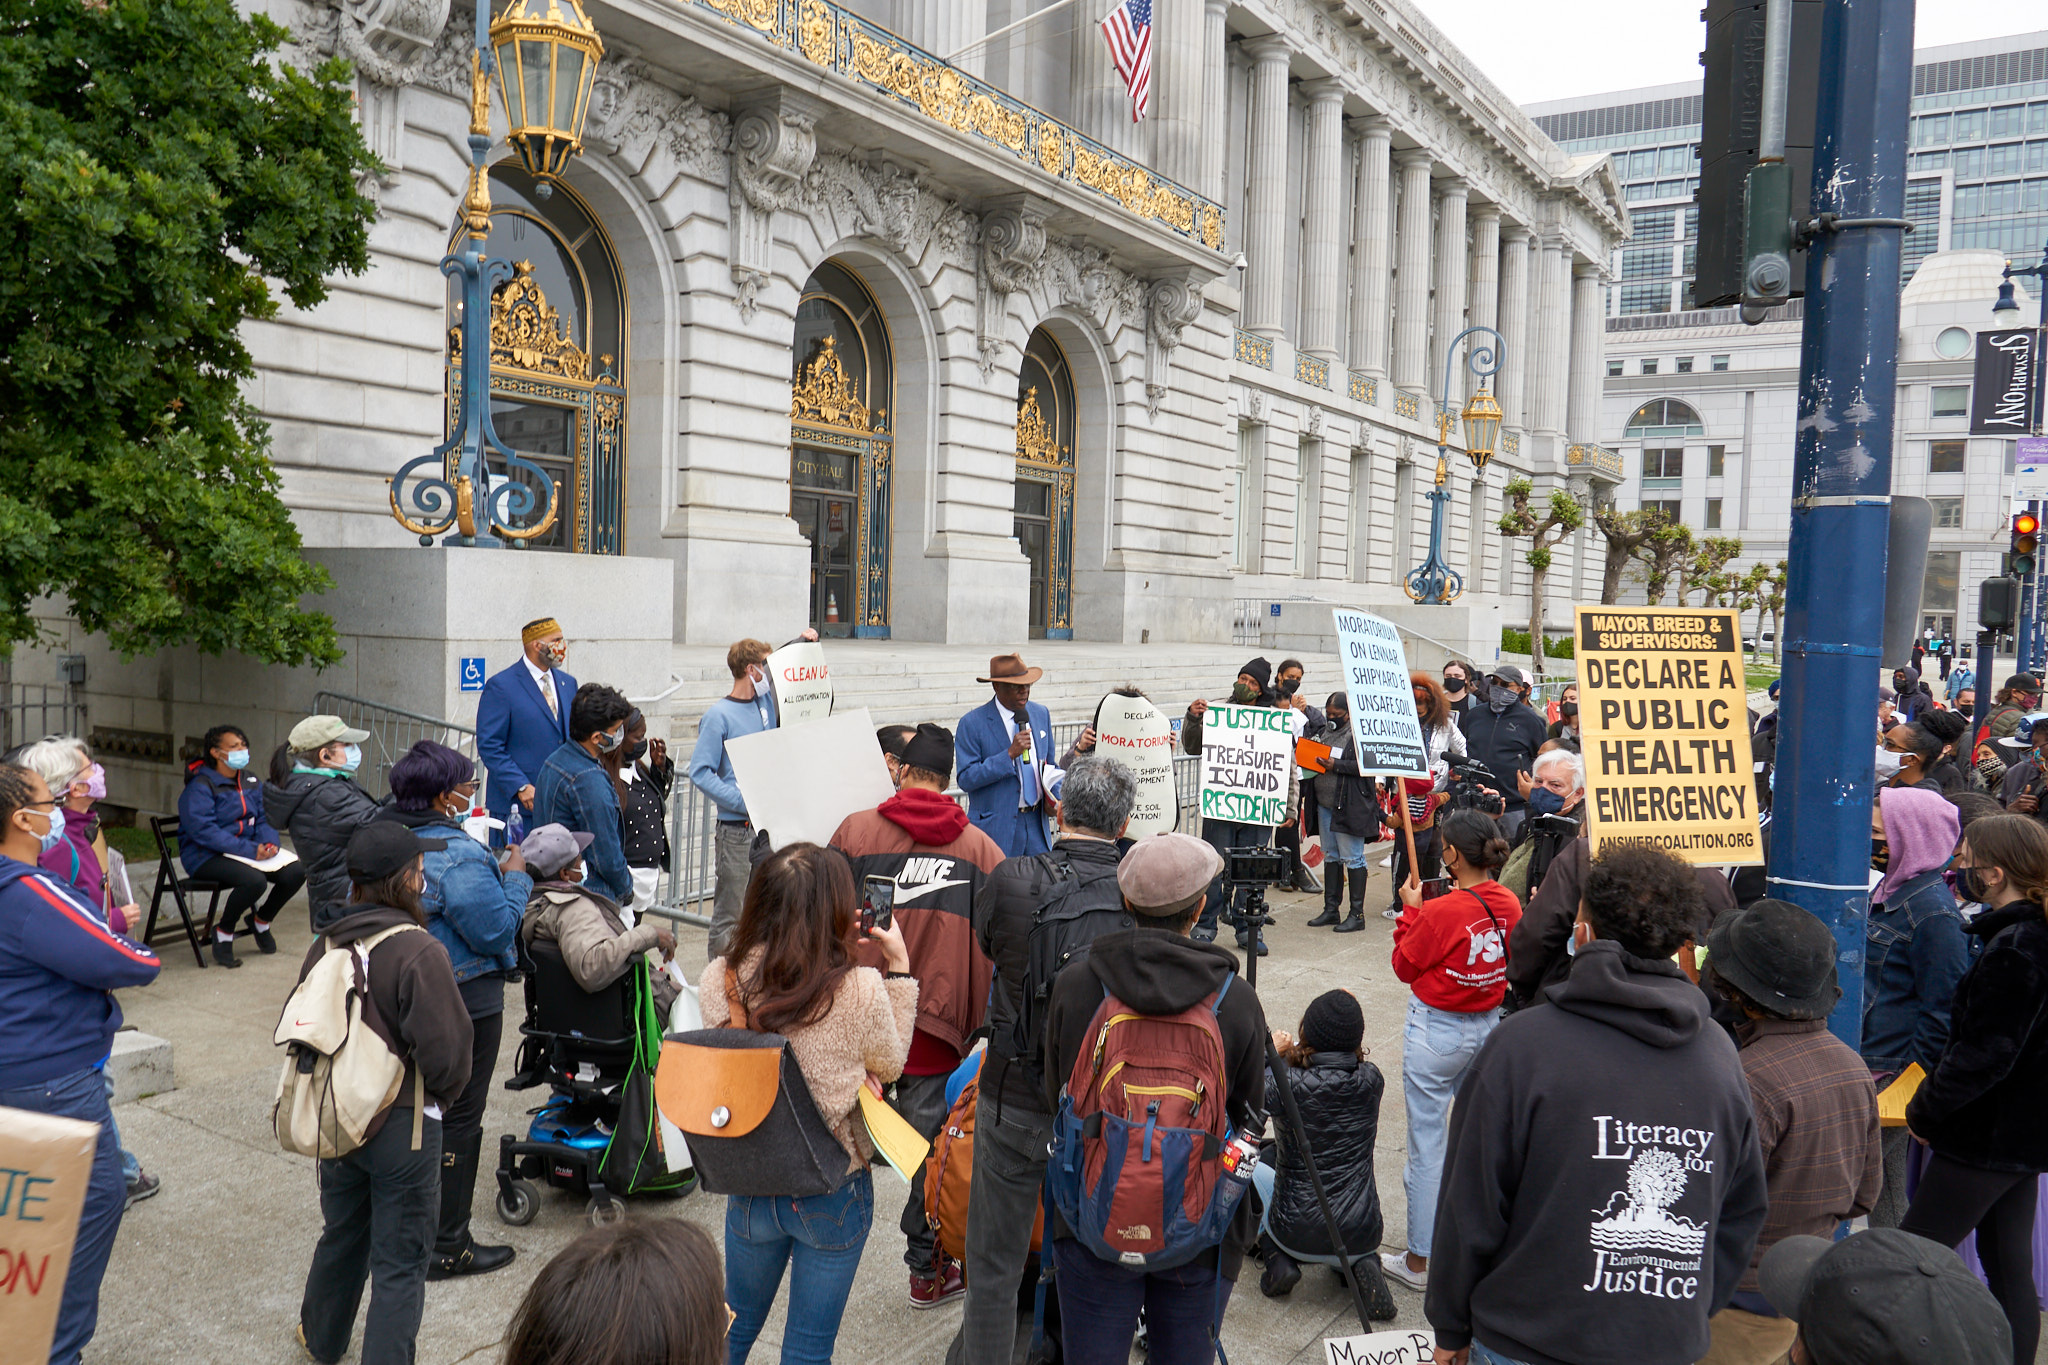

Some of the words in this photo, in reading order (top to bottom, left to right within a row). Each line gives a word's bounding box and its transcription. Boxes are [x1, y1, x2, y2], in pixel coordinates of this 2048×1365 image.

[797, 460, 819, 475] CITY
[821, 464, 844, 478] HALL
[1338, 615, 1399, 642] MORATORIUM
[1592, 615, 1650, 632] MAYOR
[1653, 616, 1706, 633] BREED
[1709, 617, 1722, 633] &
[1350, 641, 1367, 659] ON
[1369, 642, 1400, 666] LENNAR
[1599, 633, 1718, 650] SUPERVISORS:
[784, 665, 818, 682] CLEAN
[1352, 667, 1398, 689] SHIPYARD
[1399, 673, 1406, 691] &
[1586, 658, 1710, 689] DECLARE
[1719, 659, 1736, 689] A
[784, 695, 794, 703] ALL
[1356, 693, 1395, 714] UNSAFE
[1395, 698, 1412, 717] SOIL
[1124, 711, 1155, 720] DECLARE
[1206, 705, 1293, 734] JUSTICE
[1600, 699, 1730, 730] PUBLIC
[1101, 733, 1170, 748] MORATORIUM
[1245, 734, 1254, 749] 4
[1360, 718, 1418, 741] EXCAVATION!
[1202, 744, 1284, 771] TREASURE
[1363, 743, 1376, 754] Party
[1376, 743, 1384, 752] for
[1600, 739, 1736, 775] HEALTH
[1140, 765, 1170, 776] SHIPYARD
[1375, 753, 1418, 770] PSLweb.org
[1136, 775, 1165, 784] OPMENT
[1208, 767, 1279, 792] ISLAND
[1202, 788, 1286, 824] RESIDENTS
[1595, 785, 1746, 823] EMERGENCY
[1129, 812, 1161, 821] VATION!
[899, 857, 956, 884] NIKE
[1592, 1115, 1715, 1159] Literacy
[555, 1165, 573, 1174] Pride
[1222, 1154, 1234, 1167] AR
[1684, 1150, 1714, 1174] for
[0, 1168, 56, 1222] TE
[1583, 1248, 1698, 1299] Justice
[1608, 1252, 1702, 1271] Environmental
[1330, 1341, 1409, 1365] Mayor
[1408, 1334, 1434, 1363] B
